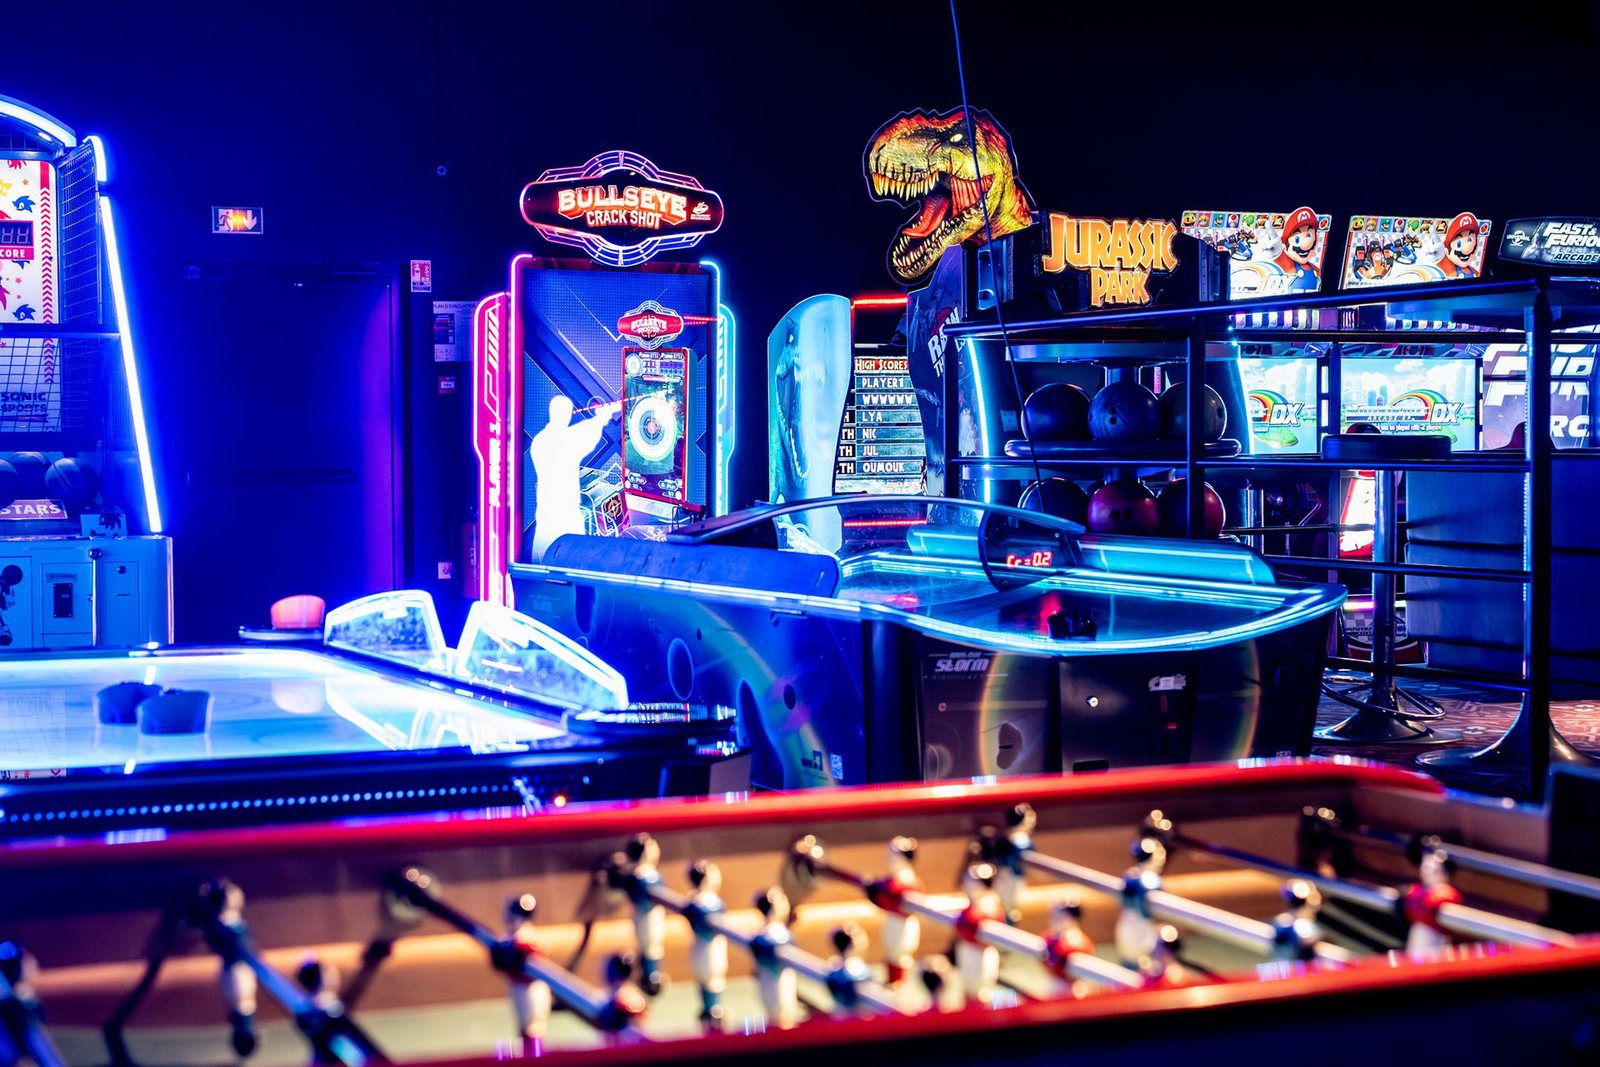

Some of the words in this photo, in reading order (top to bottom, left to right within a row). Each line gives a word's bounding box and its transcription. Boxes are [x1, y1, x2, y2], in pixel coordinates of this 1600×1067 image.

[558, 185, 687, 219] BULLSEYE
[586, 211, 628, 227] CRACK
[630, 209, 662, 229] SHOT
[1543, 222, 1593, 236] FAST
[1043, 213, 1178, 272] JURASSIC
[1554, 253, 1599, 263] ARCADE
[1091, 267, 1150, 306] PARK
[855, 359, 875, 370] HIGH
[879, 359, 908, 370] SCORES
[862, 378, 904, 388] PLAYER1
[1, 391, 47, 401] SONIC
[862, 395, 913, 404] WWWWWW
[1, 403, 48, 412] SPORTS
[1430, 402, 1464, 424] DX
[862, 412, 882, 422] LYA
[1269, 403, 1304, 426] DX
[842, 429, 854, 439] TH
[840, 446, 852, 456] TH
[863, 446, 878, 456] JUL
[836, 463, 854, 474] TH
[0, 504, 61, 515] STARS
